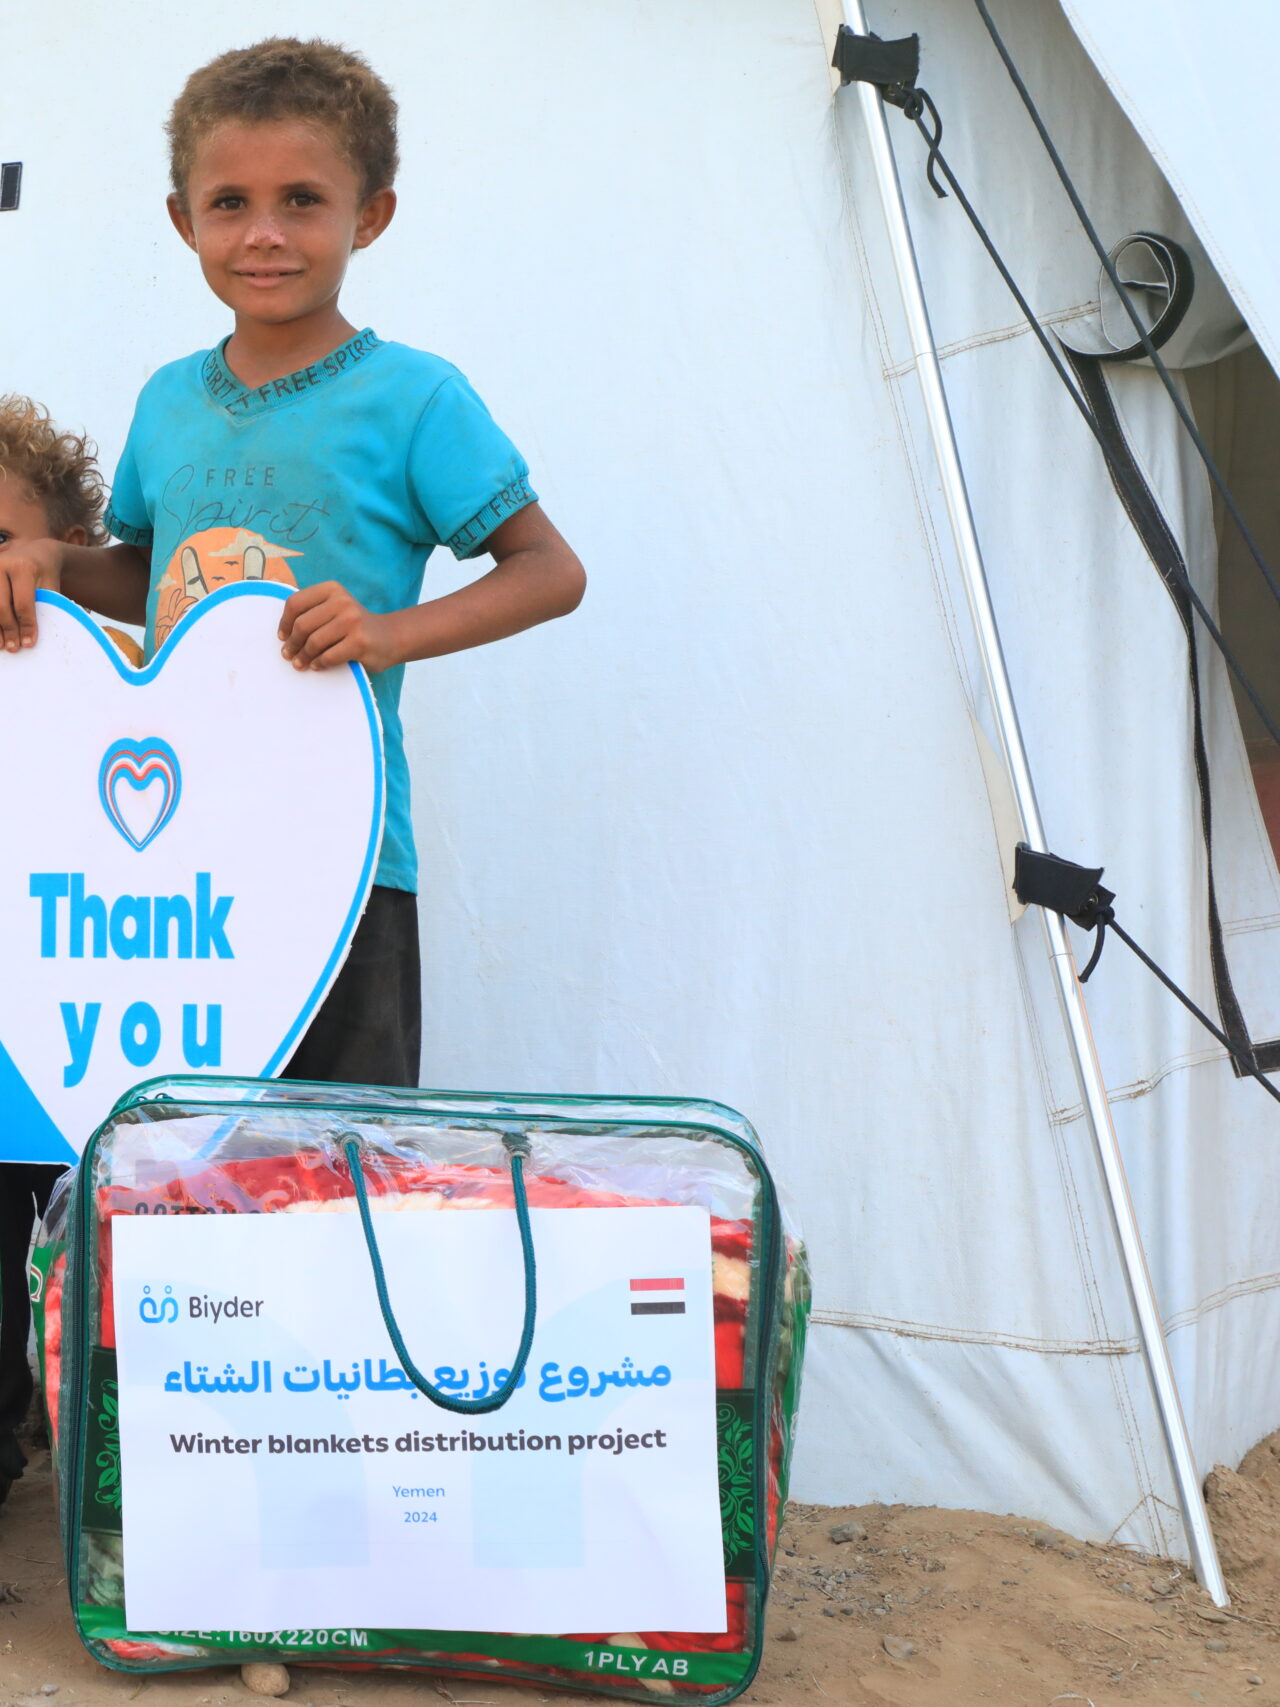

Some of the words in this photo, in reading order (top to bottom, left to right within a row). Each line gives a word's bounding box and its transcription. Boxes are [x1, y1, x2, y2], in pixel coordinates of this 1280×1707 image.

[257, 365, 322, 403] FREE
[205, 466, 276, 488] FREE
[157, 464, 331, 567] Spirit
[29, 872, 235, 960] Thank
[60, 1001, 222, 1088] you
[188, 1295, 264, 1323] Biyder
[164, 1360, 273, 1394] الشتاء
[433, 1361, 526, 1400] وزيع
[537, 1357, 672, 1403] مشروع
[169, 1432, 262, 1454] Winter
[267, 1431, 389, 1453] blankets
[394, 1428, 562, 1453] distribution
[567, 1427, 667, 1454] project
[392, 1485, 446, 1498] Yemen
[403, 1511, 438, 1524] 2024
[584, 1651, 648, 1672] 1PLY
[651, 1658, 689, 1676] AB
